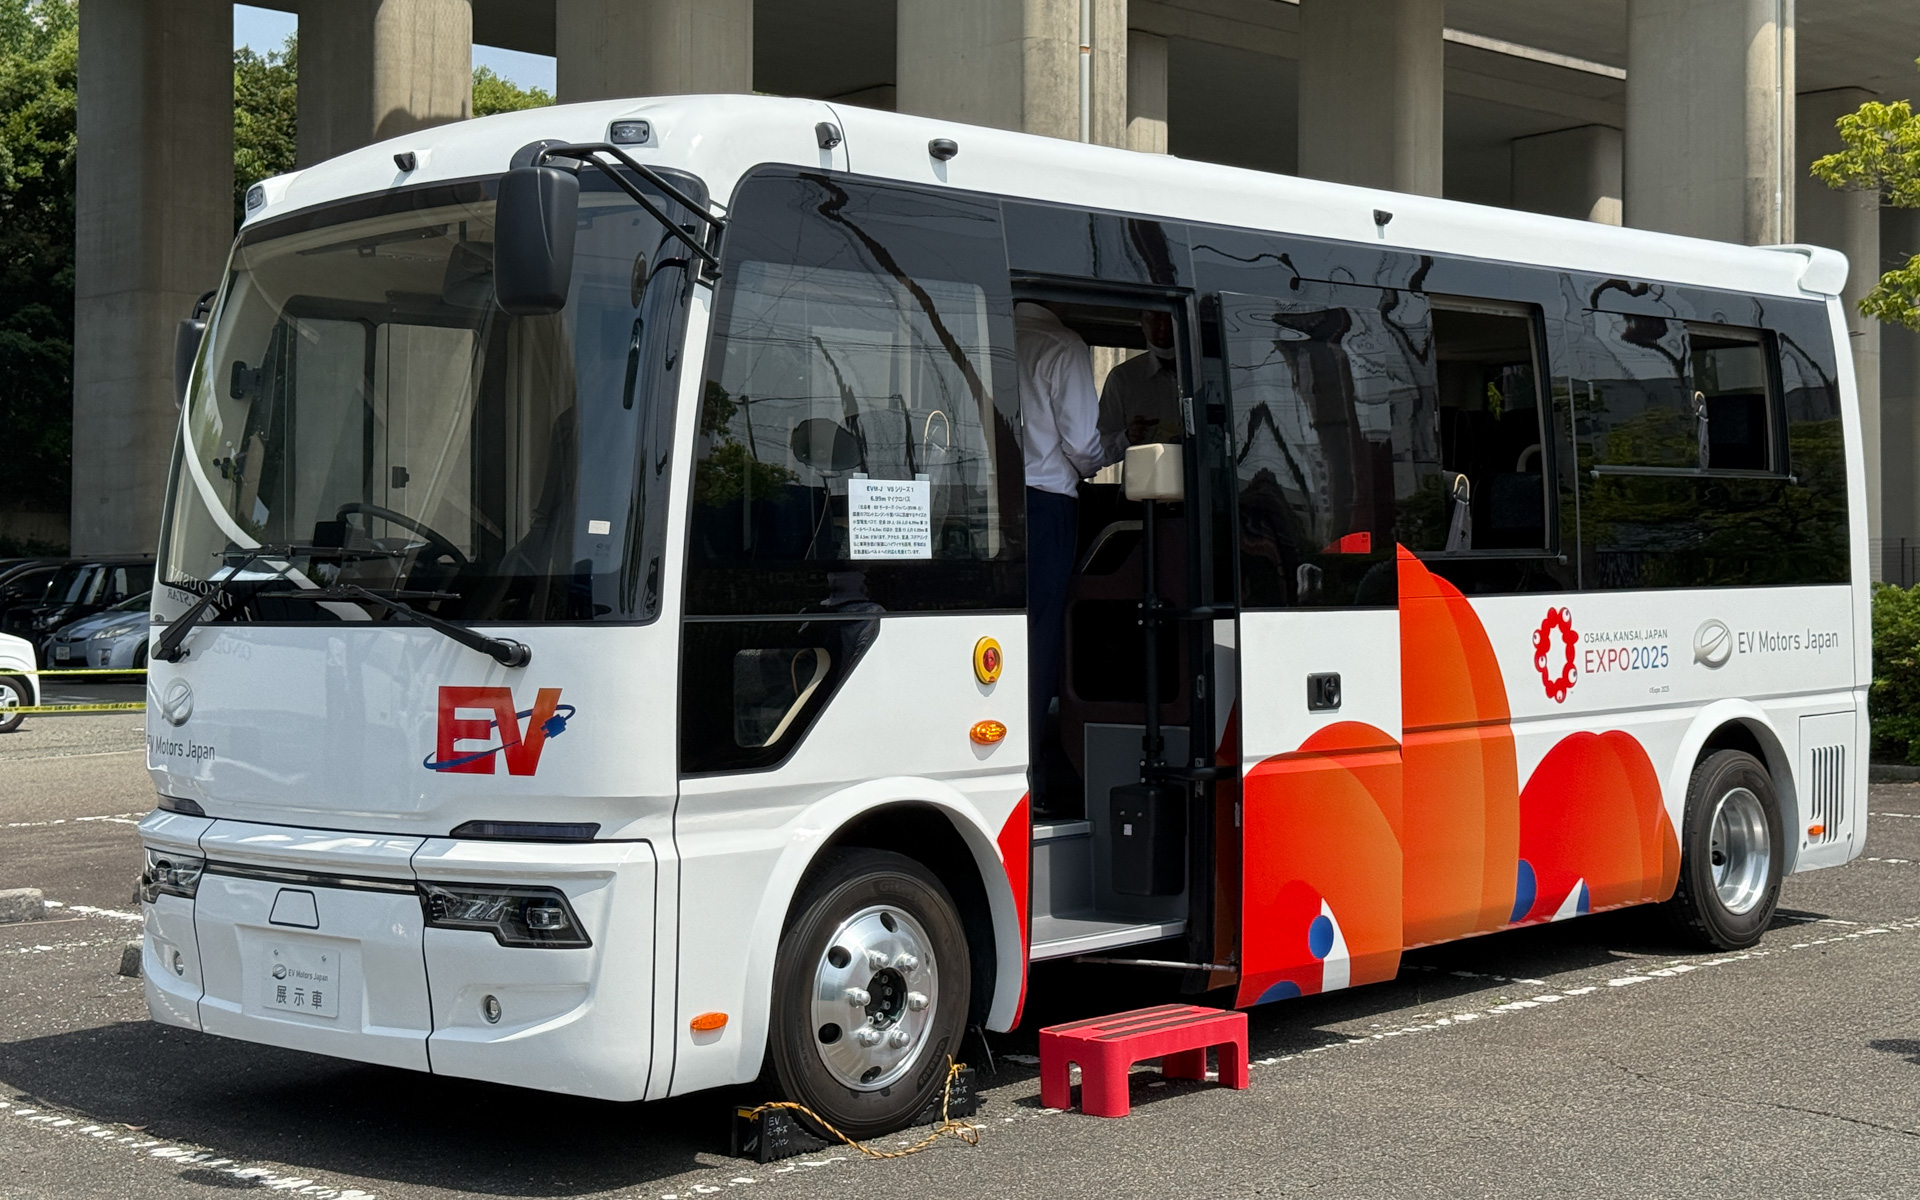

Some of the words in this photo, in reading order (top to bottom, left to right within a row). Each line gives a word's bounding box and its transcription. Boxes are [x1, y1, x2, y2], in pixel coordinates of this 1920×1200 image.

[1584, 632, 1613, 644] OSAKA,
[1613, 630, 1643, 642] KANSAI,
[1644, 629, 1668, 640] JAPAN
[1738, 630, 1755, 654] EV
[1758, 630, 1801, 653] Motors
[1804, 628, 1839, 654] Japan
[1585, 645, 1669, 674] EXPO2025
[435, 685, 564, 777] EV
[155, 735, 184, 757] Motors
[186, 739, 215, 764] Japan
[288, 969, 296, 977] EV
[296, 970, 313, 980] Motors
[314, 973, 328, 982] Japan
[276, 984, 323, 1010] 展示車
[768, 1115, 781, 1127] EV
